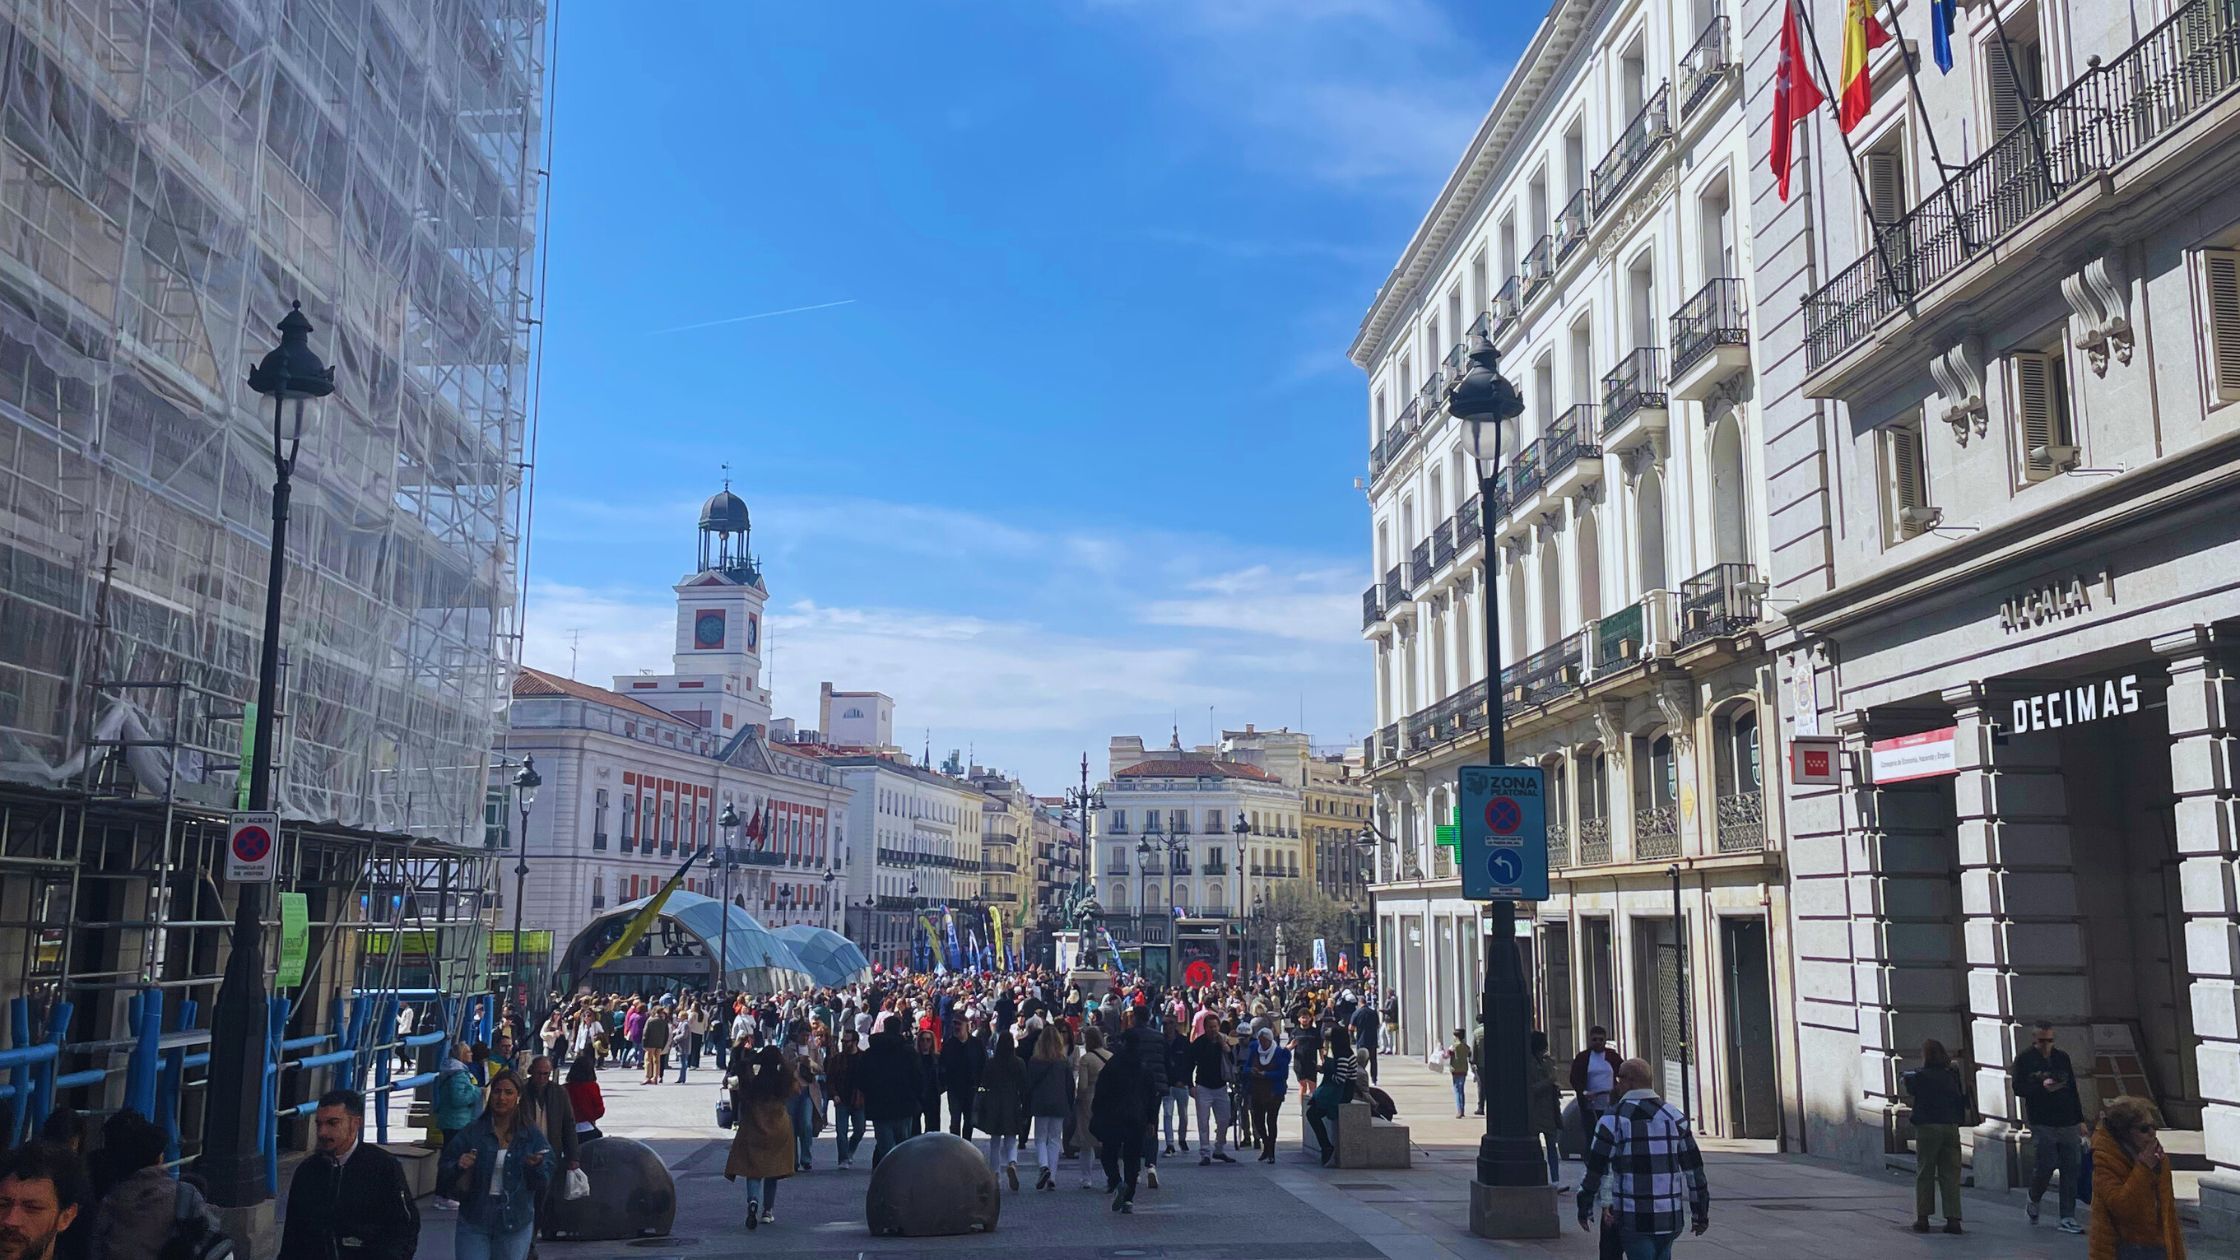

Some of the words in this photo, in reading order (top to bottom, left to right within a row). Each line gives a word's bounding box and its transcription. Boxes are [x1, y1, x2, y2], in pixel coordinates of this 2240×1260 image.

[2099, 570, 2113, 599] 1
[2012, 674, 2139, 734] DECIMAS
[1490, 776, 1537, 789] ZONA
